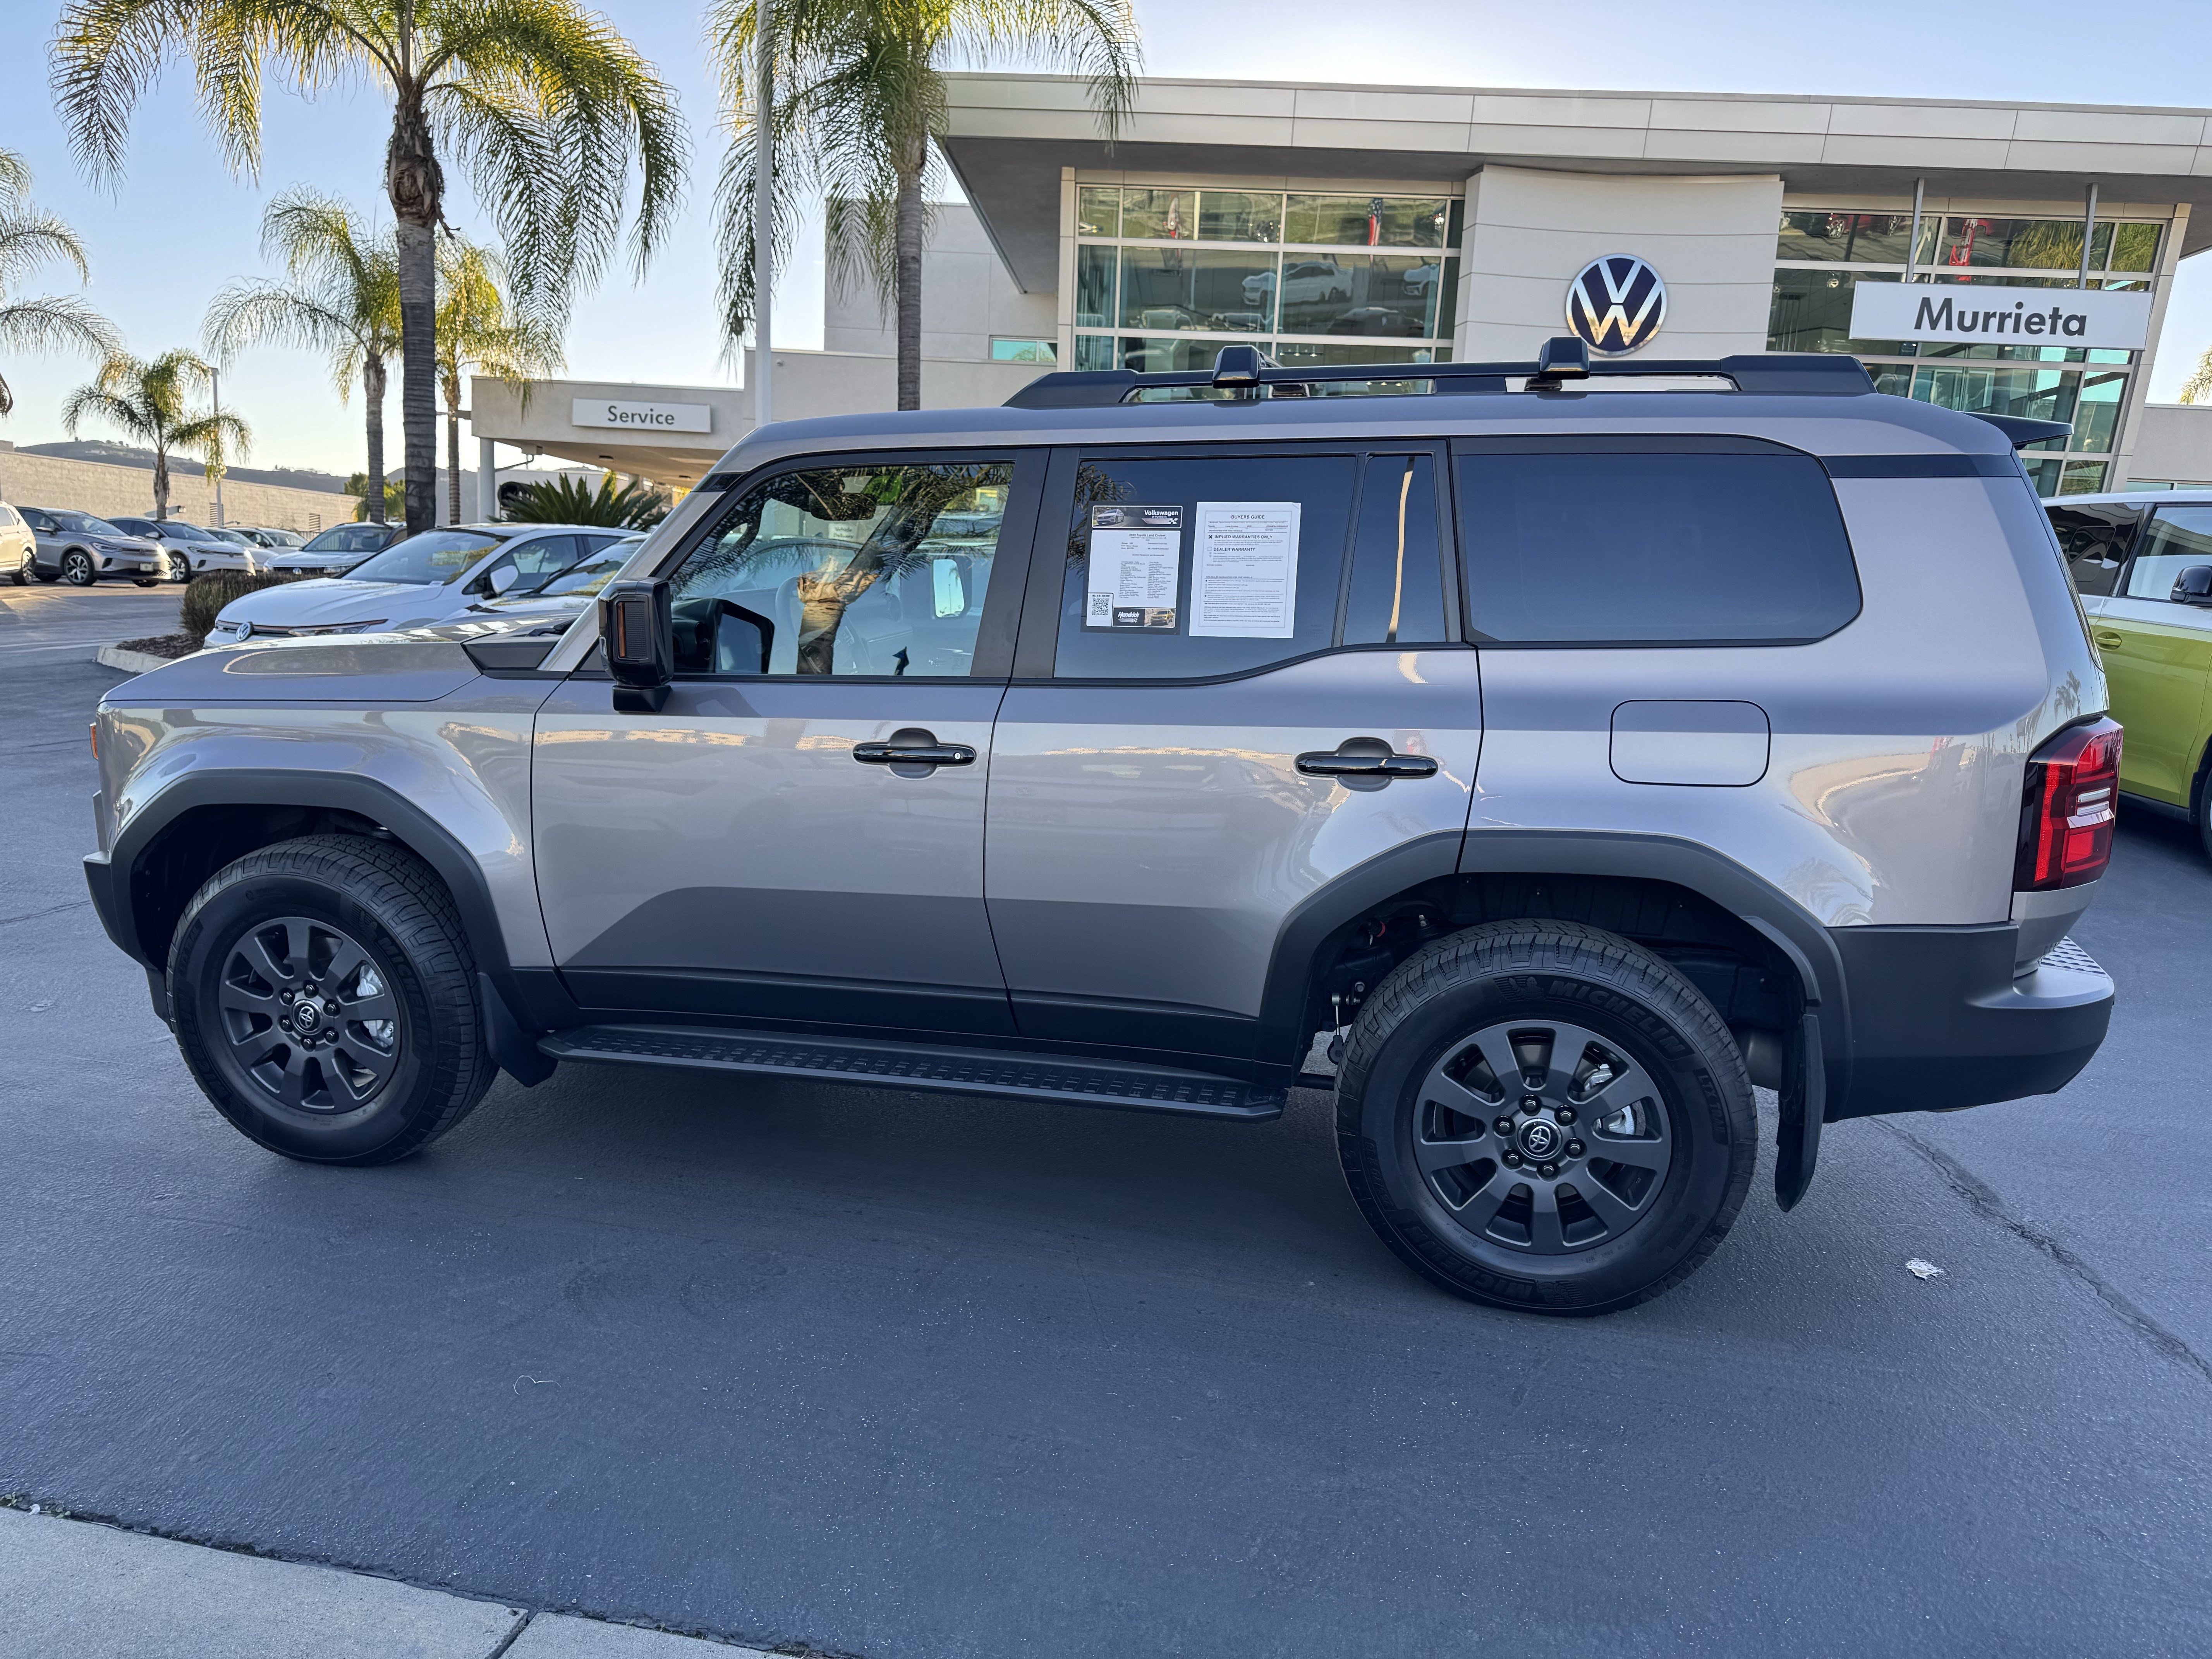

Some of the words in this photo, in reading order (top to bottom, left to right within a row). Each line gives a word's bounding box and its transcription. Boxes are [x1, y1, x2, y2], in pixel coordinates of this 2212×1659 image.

[1914, 297, 2087, 336] Murrieta
[608, 405, 675, 425] Service
[378, 937, 431, 1046] MICHELIN
[1549, 979, 1685, 1054] MICHELIN
[1698, 1070, 1717, 1100] LTX
[1403, 1226, 1533, 1300] MICHELIN
